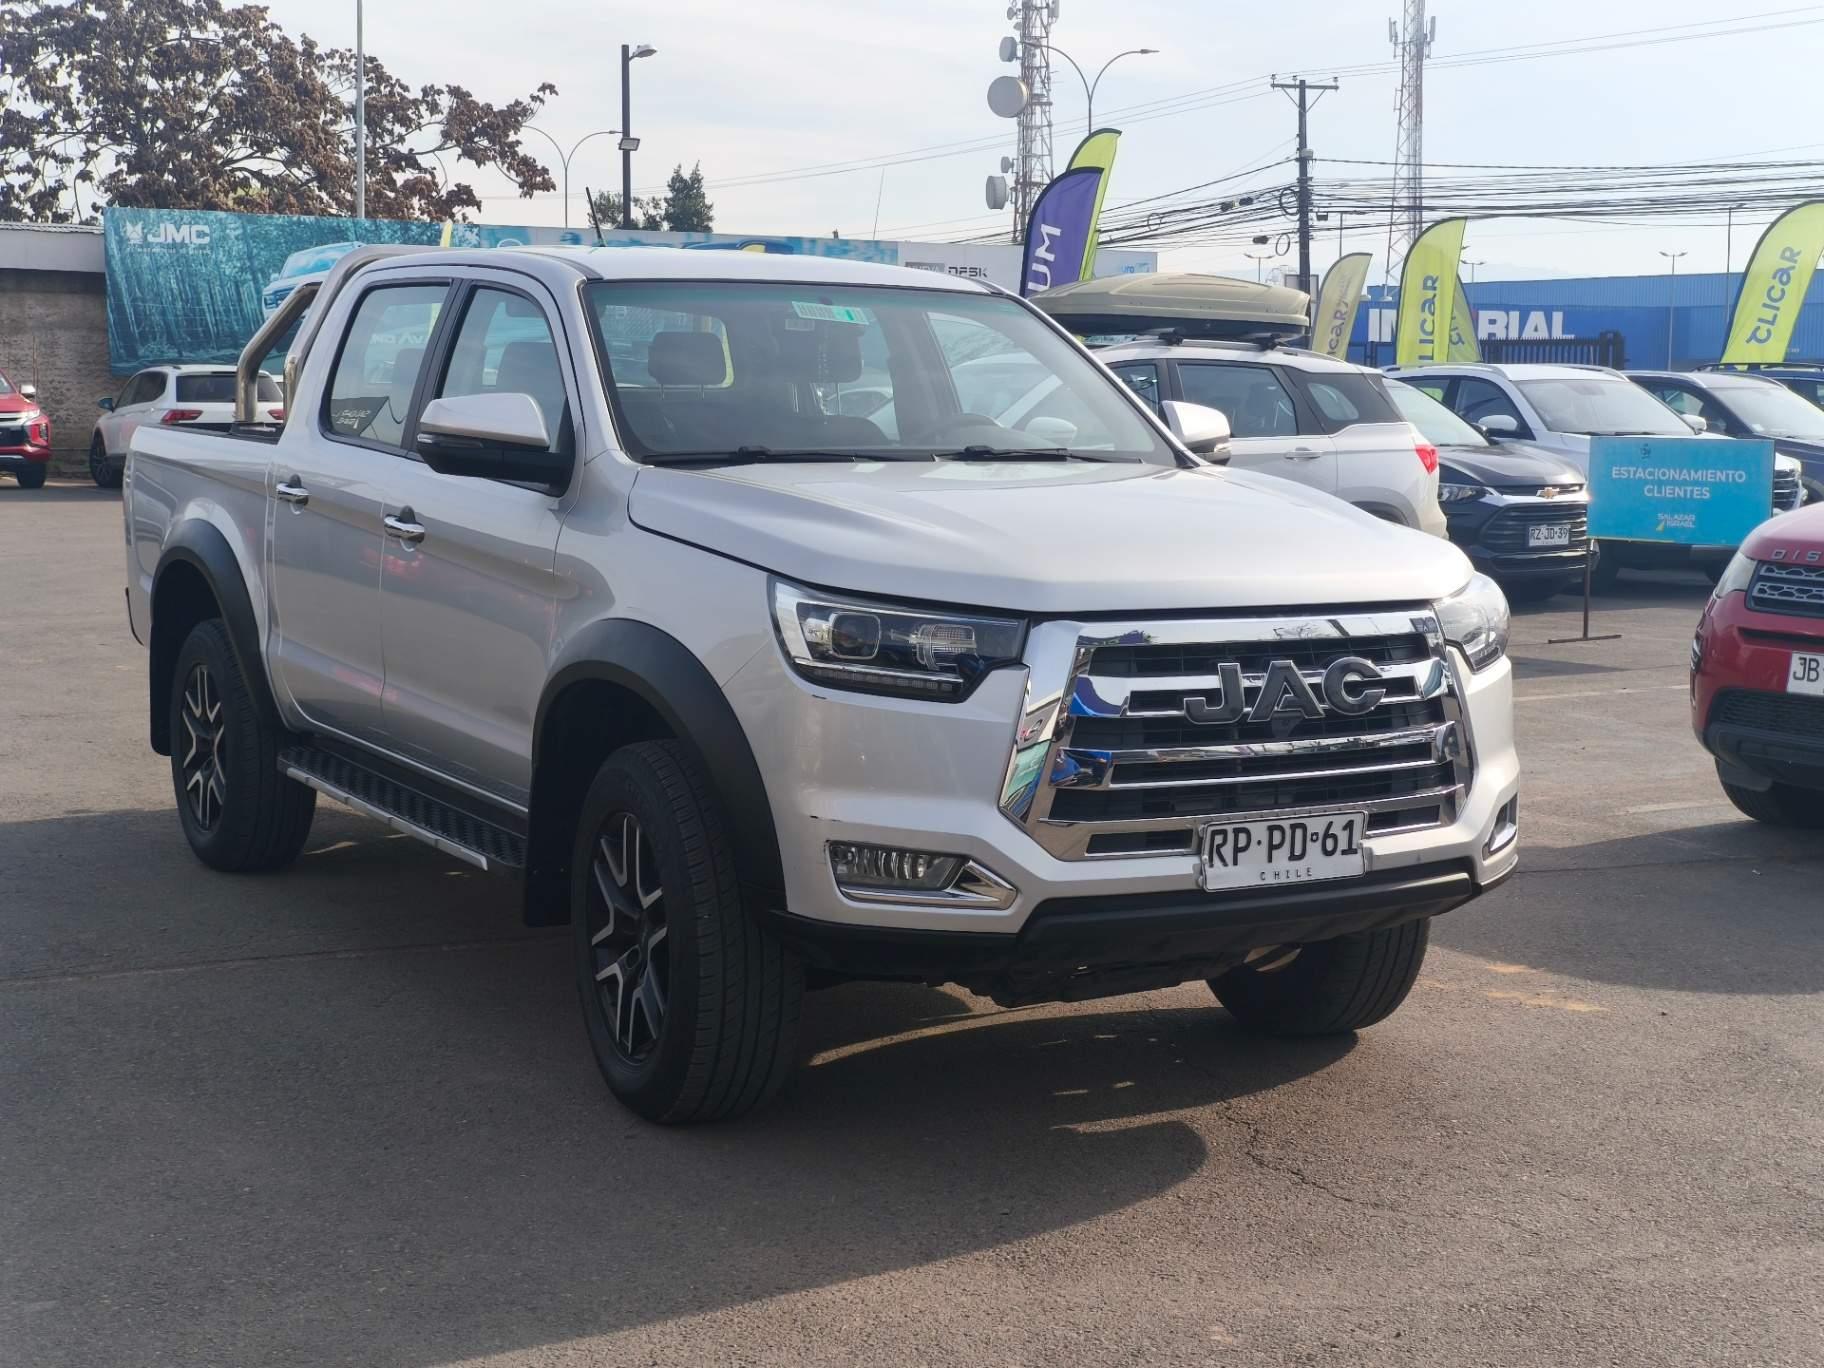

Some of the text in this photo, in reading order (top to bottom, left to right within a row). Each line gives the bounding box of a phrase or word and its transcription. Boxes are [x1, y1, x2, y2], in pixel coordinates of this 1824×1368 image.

[147, 223, 210, 244] JMC
[1611, 466, 1747, 483] ESTACIONAMIENTO
[1644, 485, 1711, 499] CLIENTES
[1184, 656, 1387, 724] JAC
[1259, 867, 1313, 881] CHILE
